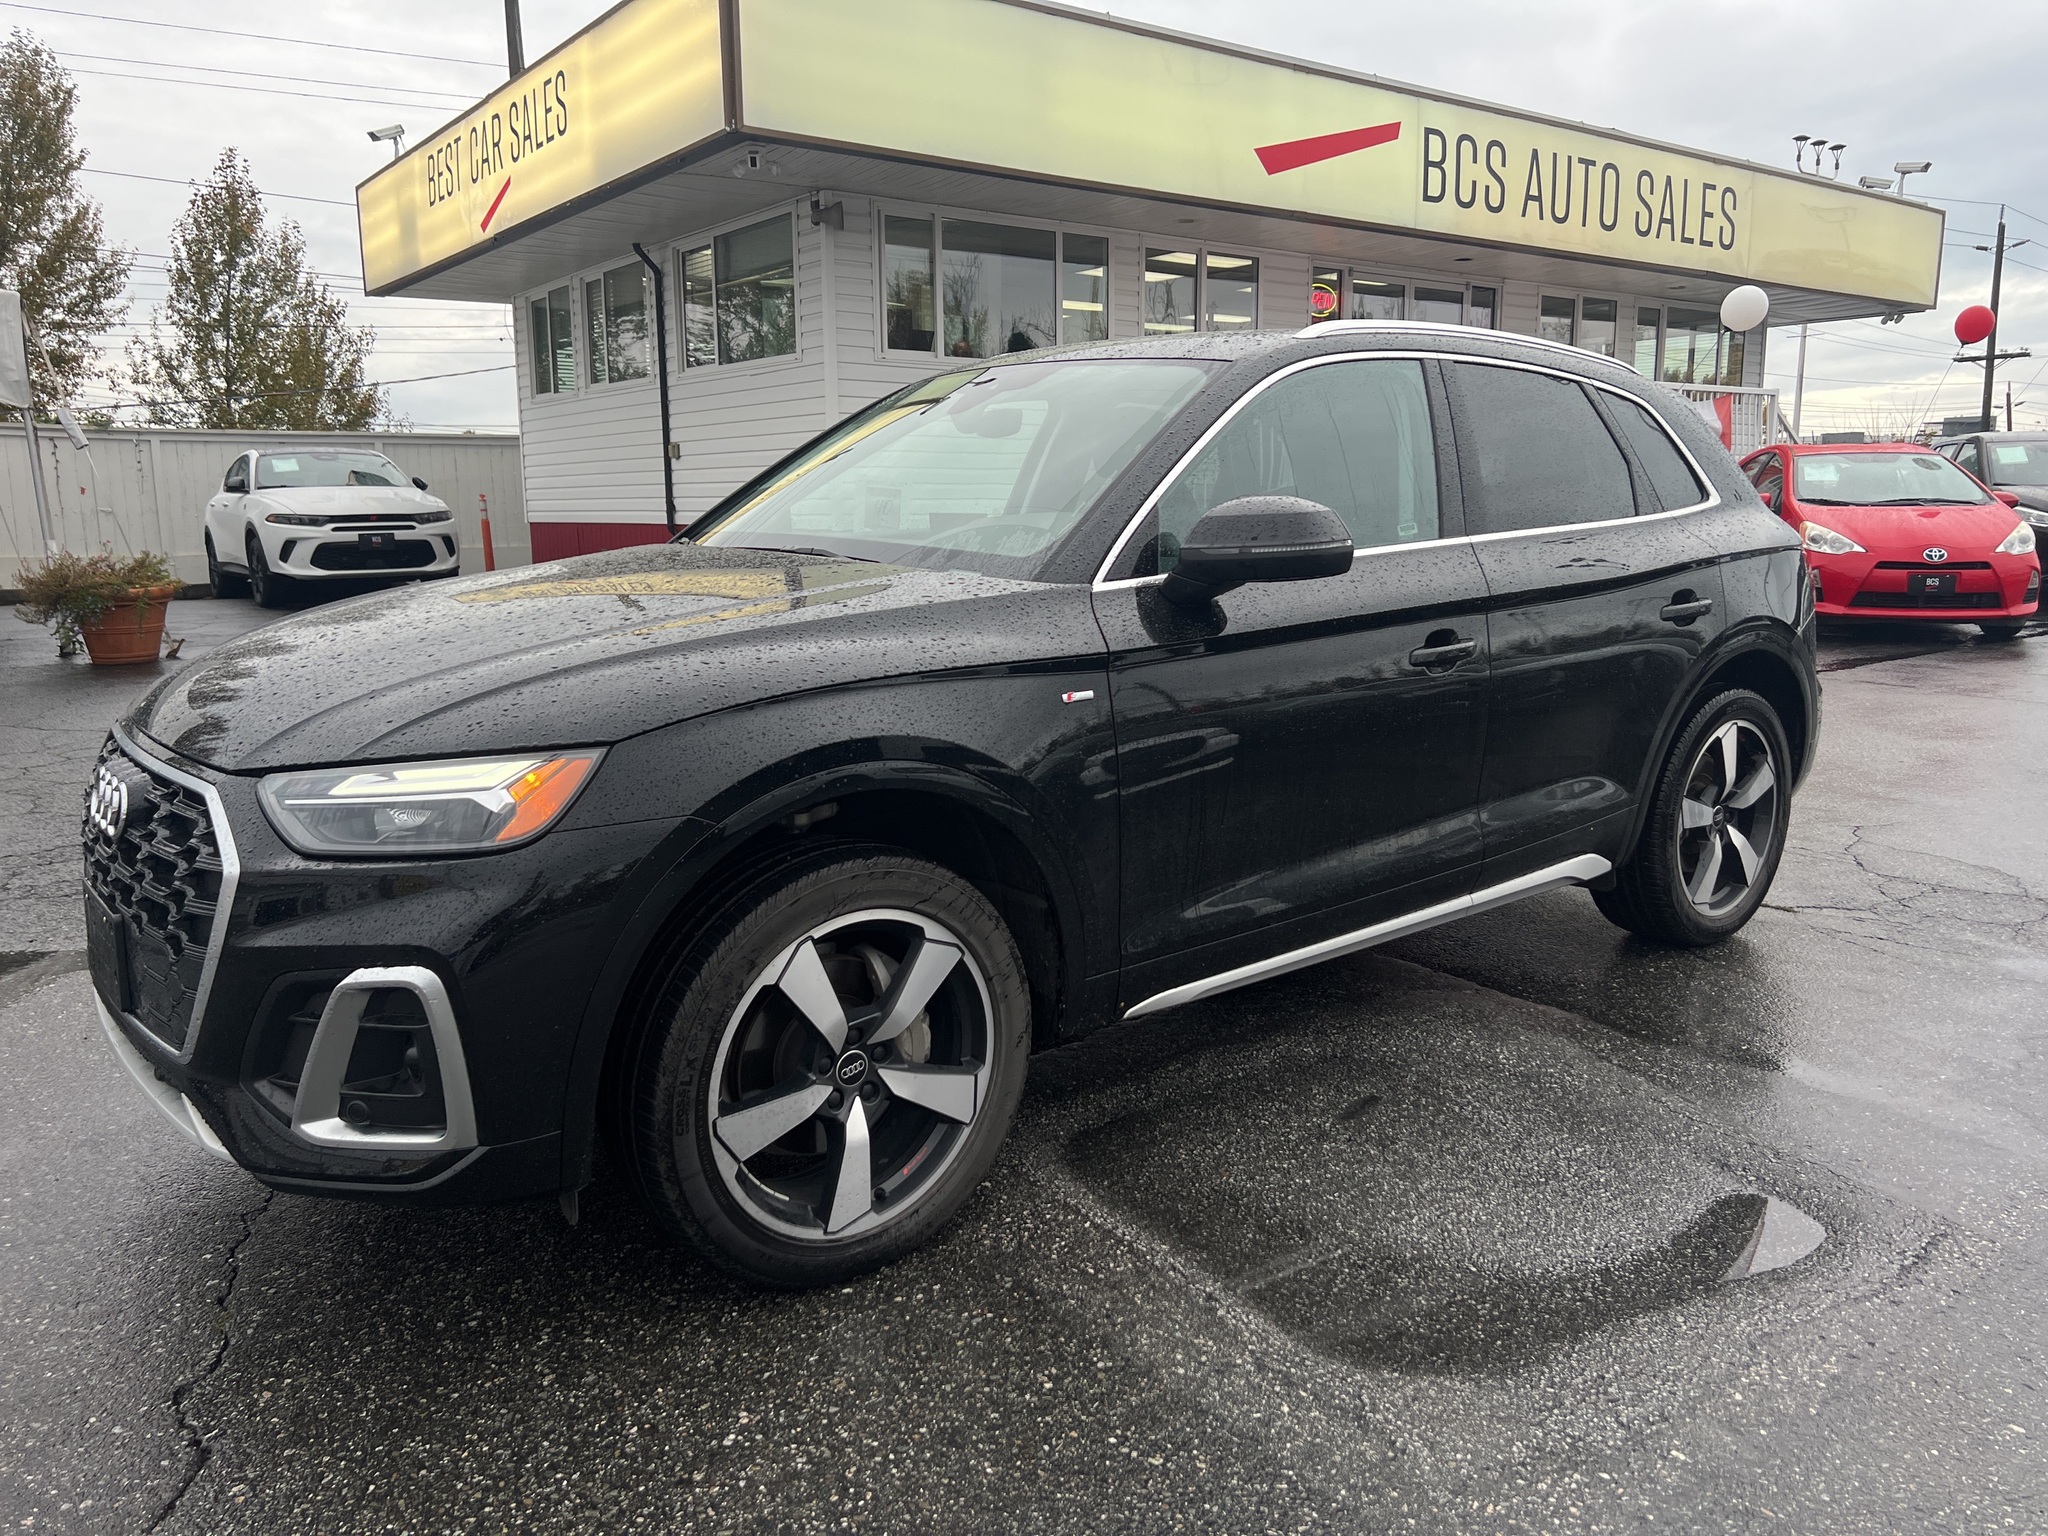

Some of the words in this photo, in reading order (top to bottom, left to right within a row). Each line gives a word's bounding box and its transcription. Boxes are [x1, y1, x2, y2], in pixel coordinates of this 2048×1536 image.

[427, 136, 461, 208] BEST
[469, 113, 504, 185] CAR
[509, 70, 567, 163] SALES
[1421, 126, 1507, 214] BCS
[1520, 147, 1621, 232] AUTO
[1634, 169, 1737, 251] SALES
[1312, 292, 1334, 309] PEN
[1926, 577, 1939, 585] BCS
